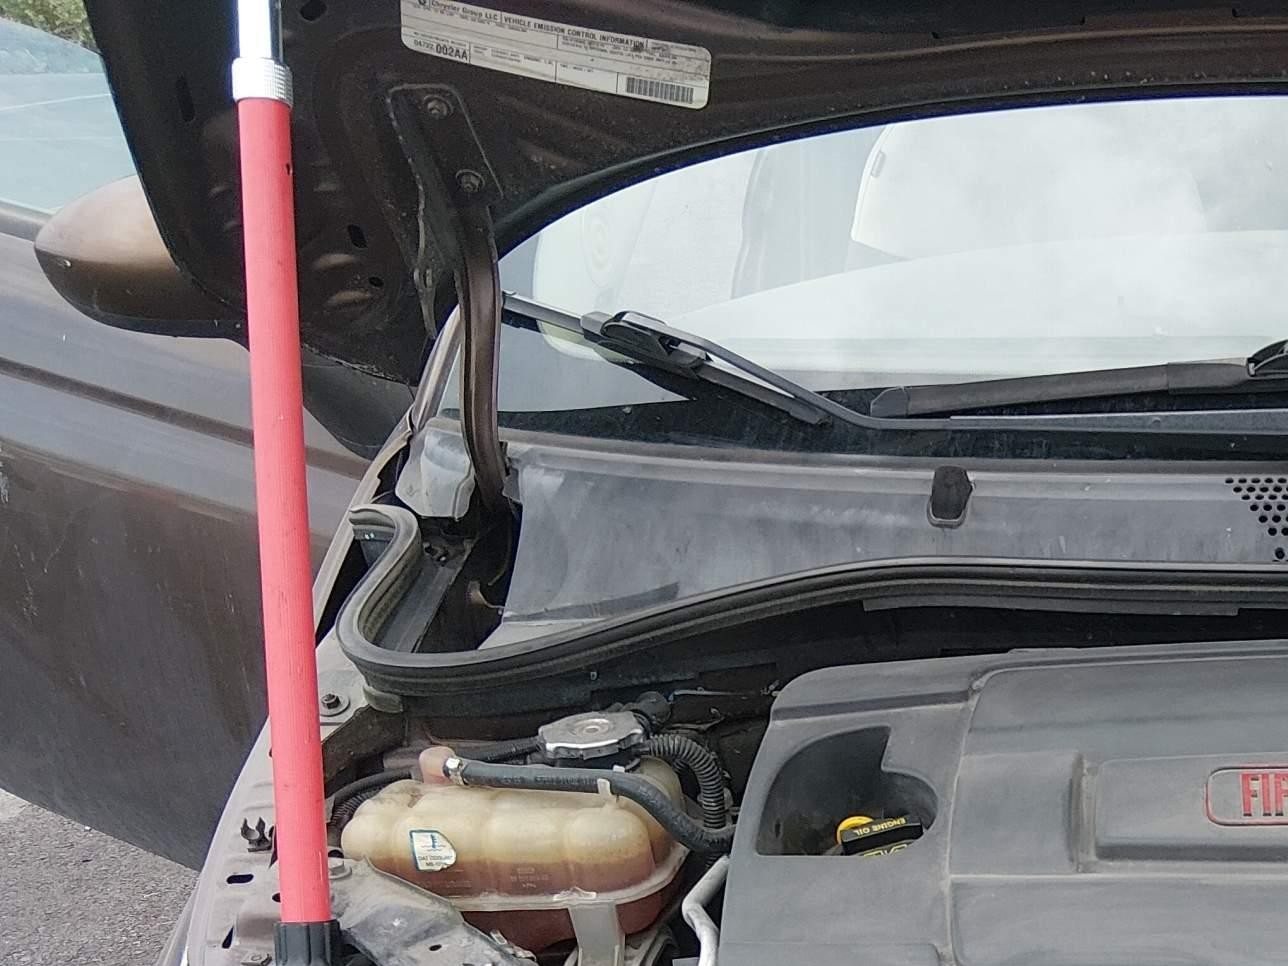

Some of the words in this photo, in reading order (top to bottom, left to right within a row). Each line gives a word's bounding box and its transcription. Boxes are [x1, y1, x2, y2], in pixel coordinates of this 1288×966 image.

[462, 6, 483, 18] Group
[485, 12, 498, 21] LLC
[504, 17, 531, 28] VEHICLE
[533, 22, 565, 34] EMISSION
[567, 28, 597, 41] CONTROL
[599, 34, 645, 49] INFORMATION
[436, 43, 468, 60] 002AA
[853, 827, 870, 836] OIL
[871, 817, 906, 832] ENGINE
